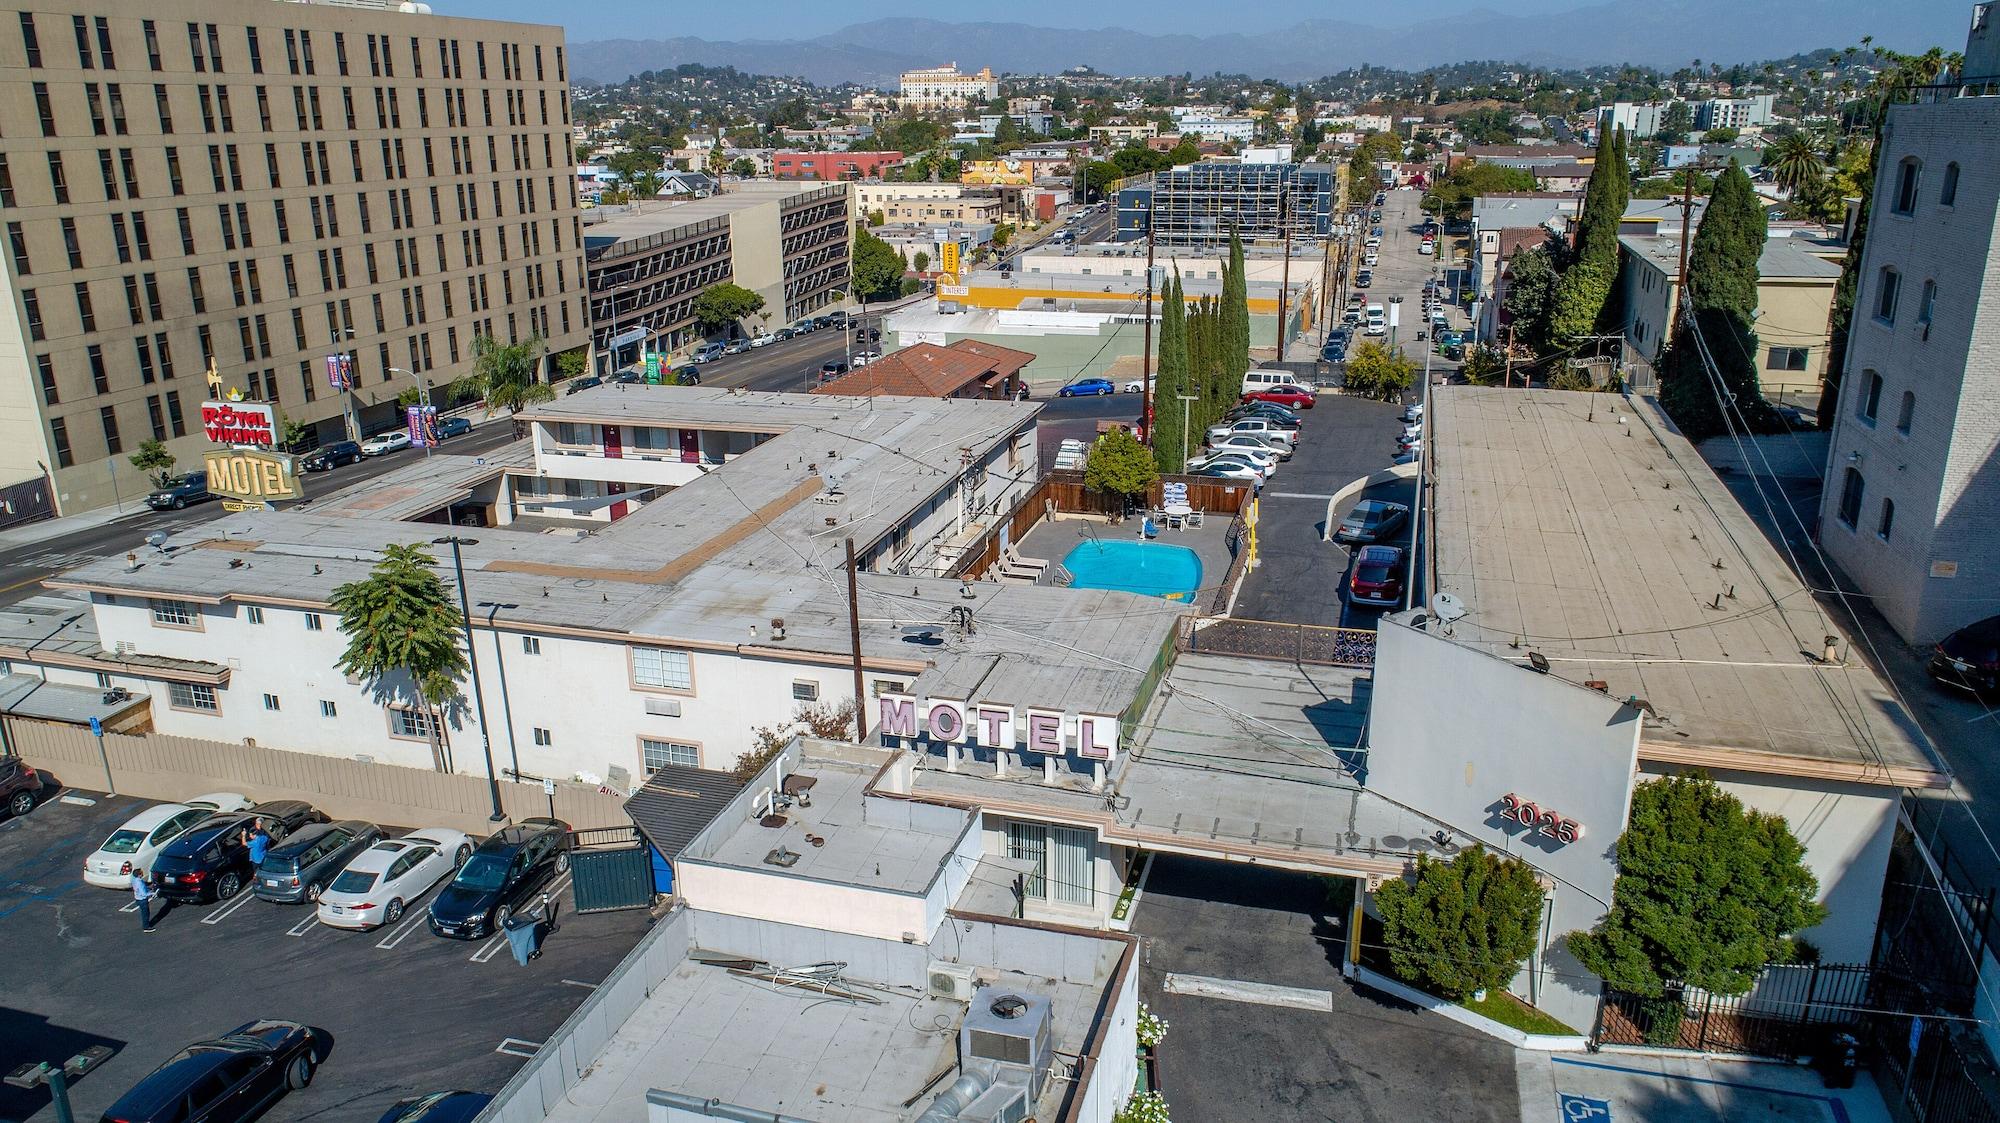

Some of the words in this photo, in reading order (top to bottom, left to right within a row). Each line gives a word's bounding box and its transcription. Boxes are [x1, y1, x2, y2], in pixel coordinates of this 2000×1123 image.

[202, 405, 271, 429] ROYAL
[205, 427, 273, 446] VIKING
[207, 456, 293, 496] MOTEL
[880, 698, 1109, 759] MOTEL
[1499, 793, 1578, 844] 2025
